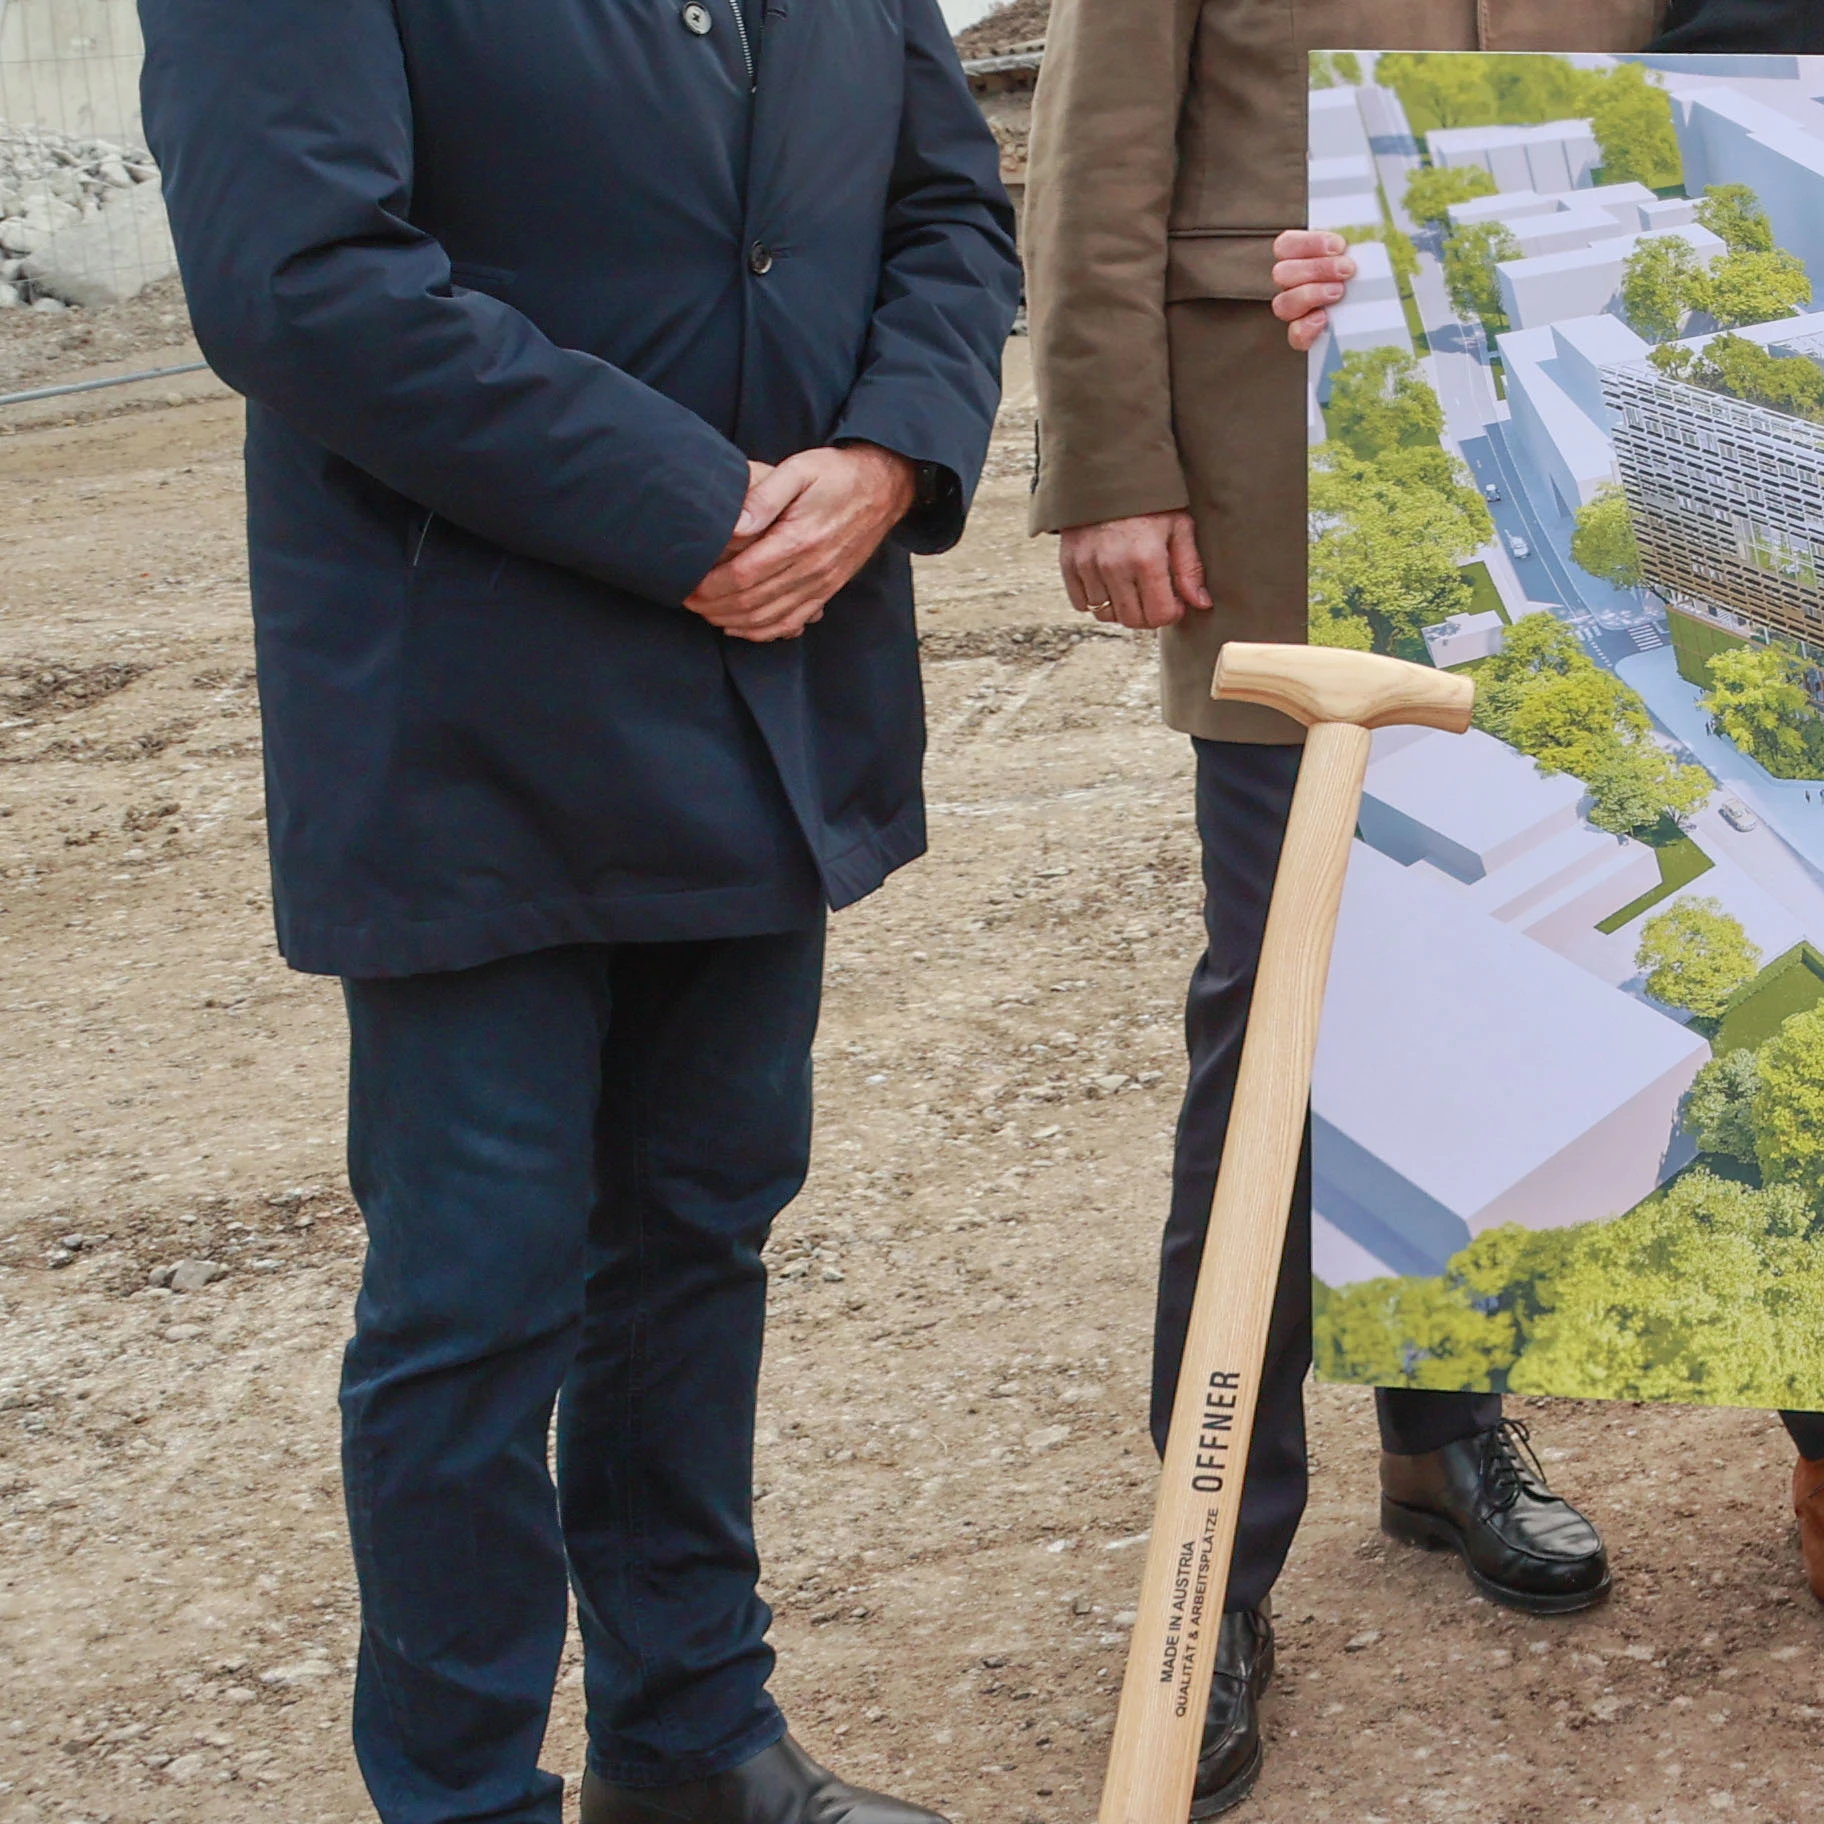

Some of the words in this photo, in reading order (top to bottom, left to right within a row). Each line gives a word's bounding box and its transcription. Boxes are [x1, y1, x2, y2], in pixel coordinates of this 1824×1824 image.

[1191, 1371, 1240, 1492] OFFNER
[1173, 1540, 1196, 1612] AUSTRIA
[1169, 1615, 1182, 1632] IN
[1188, 1630, 1199, 1640] &
[1160, 1635, 1180, 1683] MADE
